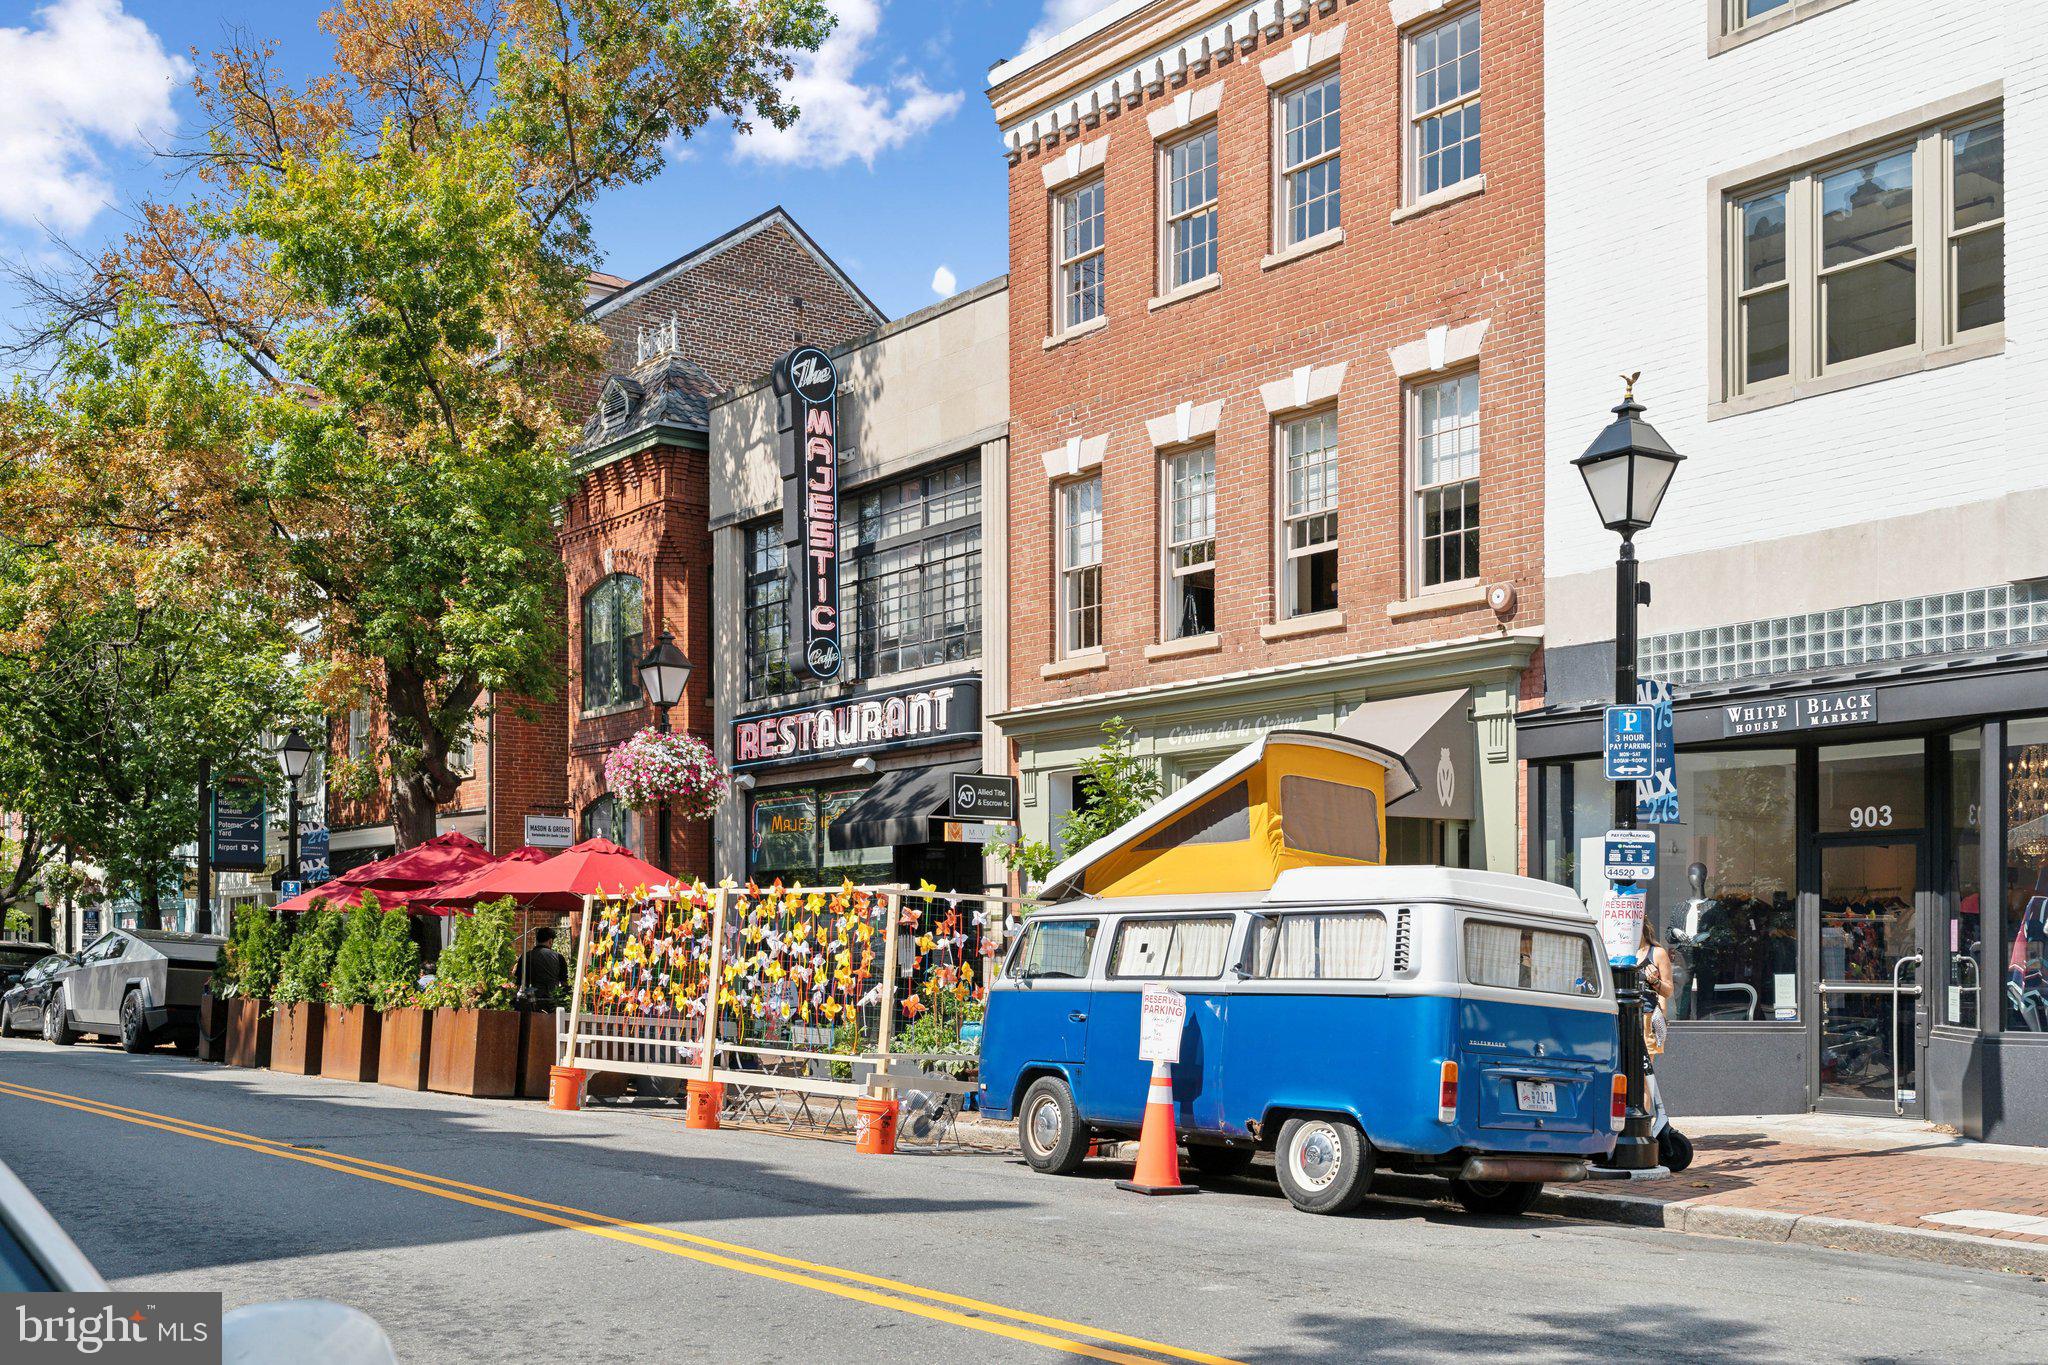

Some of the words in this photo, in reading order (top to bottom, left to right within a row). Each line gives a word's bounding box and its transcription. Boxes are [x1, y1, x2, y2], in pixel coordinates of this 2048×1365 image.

[794, 357, 831, 388] The
[806, 408, 835, 631] MAJESTIC
[1654, 700, 1673, 730] 75
[1727, 704, 1787, 723] WHITE
[1807, 694, 1872, 714] BLACK
[737, 687, 954, 760] RESTAURANT
[1623, 712, 1638, 731] P
[1735, 721, 1779, 733] HOUSE
[1810, 711, 1869, 725] MARKET
[1169, 725, 1213, 745] Crème
[1216, 721, 1233, 741] de
[1237, 719, 1251, 738] la
[978, 788, 993, 796] Allied
[994, 789, 1006, 797] Title
[218, 807, 243, 815] Museum
[1647, 793, 1679, 824] 275
[1850, 805, 1893, 828] 903
[218, 821, 243, 829] Potomac
[301, 822, 328, 835] ALX
[772, 815, 832, 834] MAJESIC
[308, 830, 330, 845] 275
[218, 843, 238, 851] Airport
[300, 857, 330, 873] ALX
[1608, 868, 1635, 876] 44520
[307, 867, 330, 880] 275
[1605, 901, 1644, 909] RESERVED
[1605, 910, 1643, 919] PARKING
[1144, 1004, 1183, 1016] PARKING
[1536, 1091, 1554, 1105] 2474
